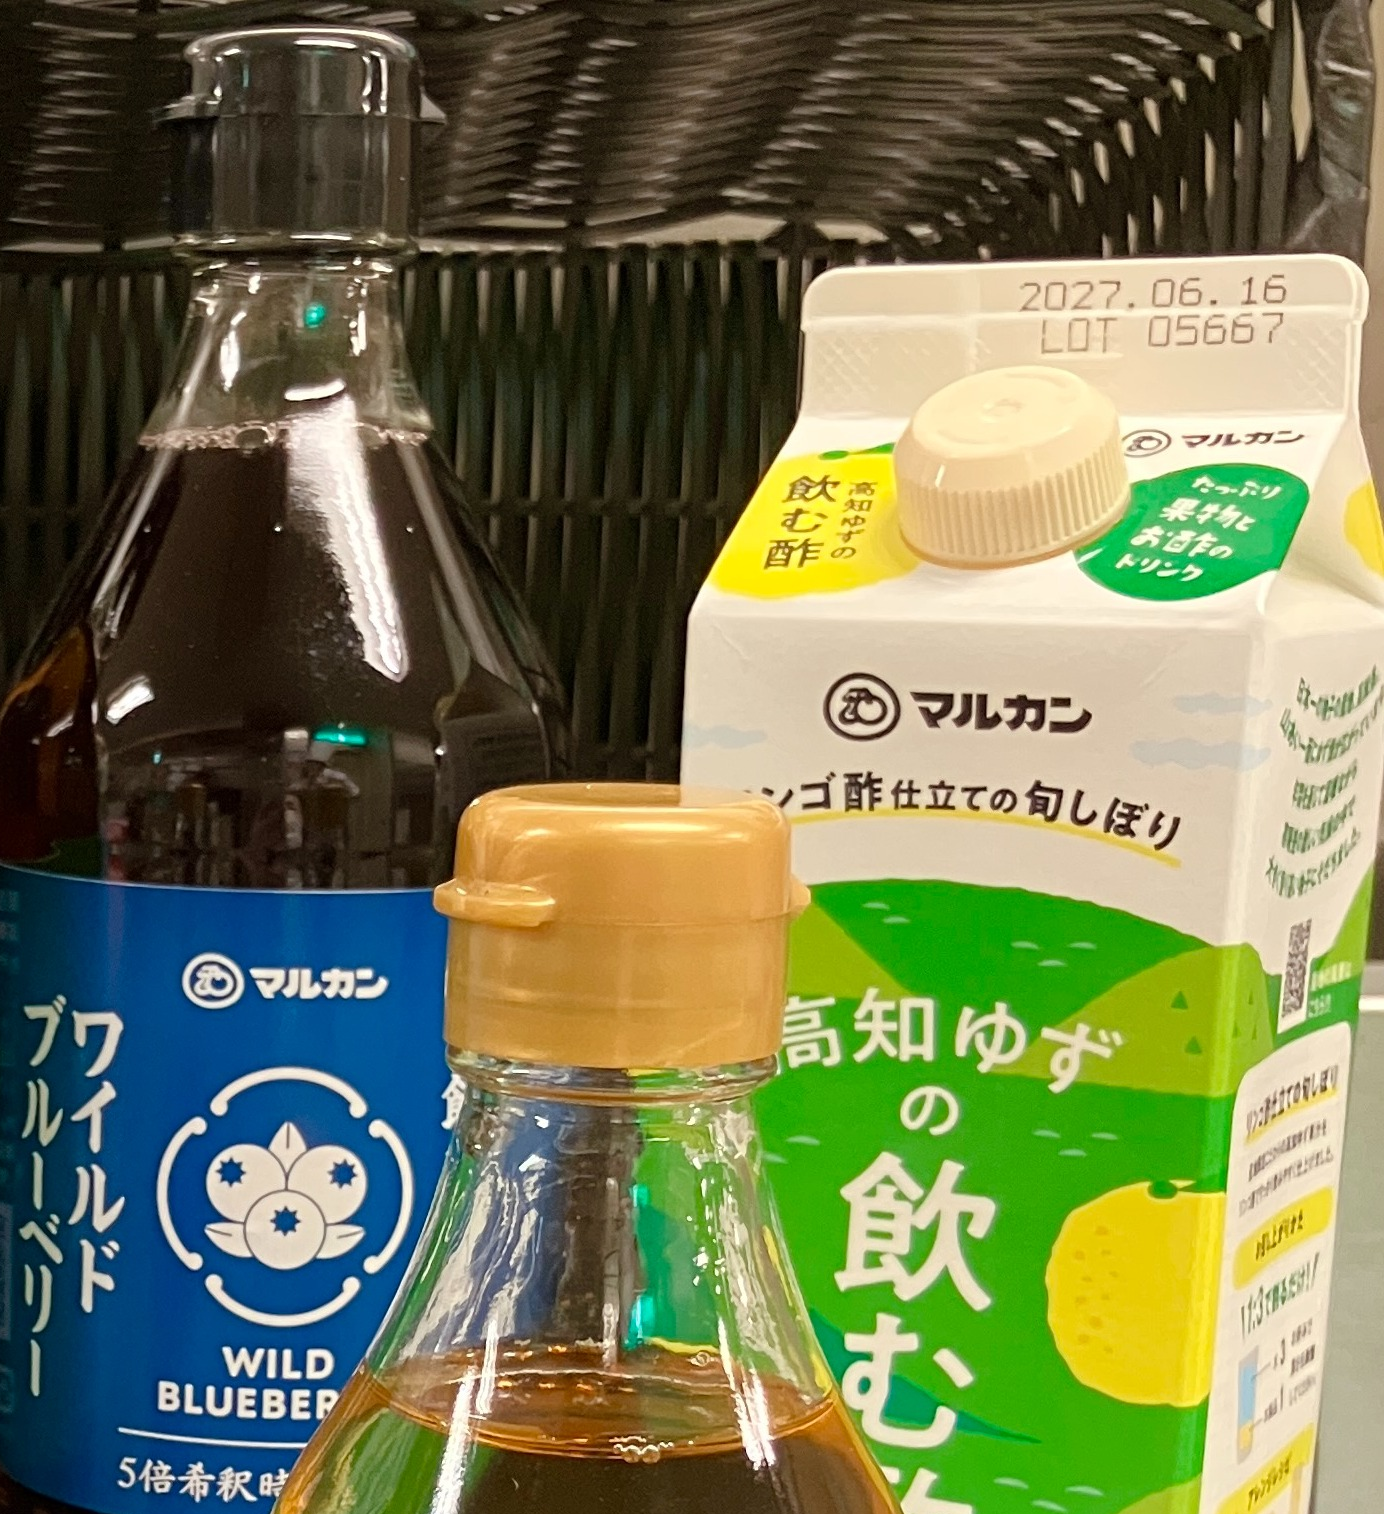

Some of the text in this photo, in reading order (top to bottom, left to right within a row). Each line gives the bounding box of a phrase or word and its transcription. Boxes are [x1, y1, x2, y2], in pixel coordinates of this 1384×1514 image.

[1019, 274, 1289, 313] 2027.06.16
[1040, 312, 1286, 355] LOT 05667
[1181, 430, 1305, 448] マルカン
[1191, 474, 1283, 500] たっぷり
[763, 474, 841, 570] 飲む酢
[829, 481, 879, 560] 高知ゆずの
[1159, 497, 1256, 531] 果物と
[1130, 525, 1234, 559] お酢の
[1115, 552, 1205, 582] ドリンク
[910, 691, 1093, 733] マルカン
[744, 771, 1182, 852] ンゴ酢仕立ての旬しぼり
[248, 966, 389, 999] マルカン
[782, 987, 1124, 1093] 高知ゆず
[69, 1005, 126, 1313] ワイルド
[19, 994, 68, 1397] ブルーベリー
[221, 1346, 336, 1381] WILD
[157, 1379, 342, 1421] BLUEBER
